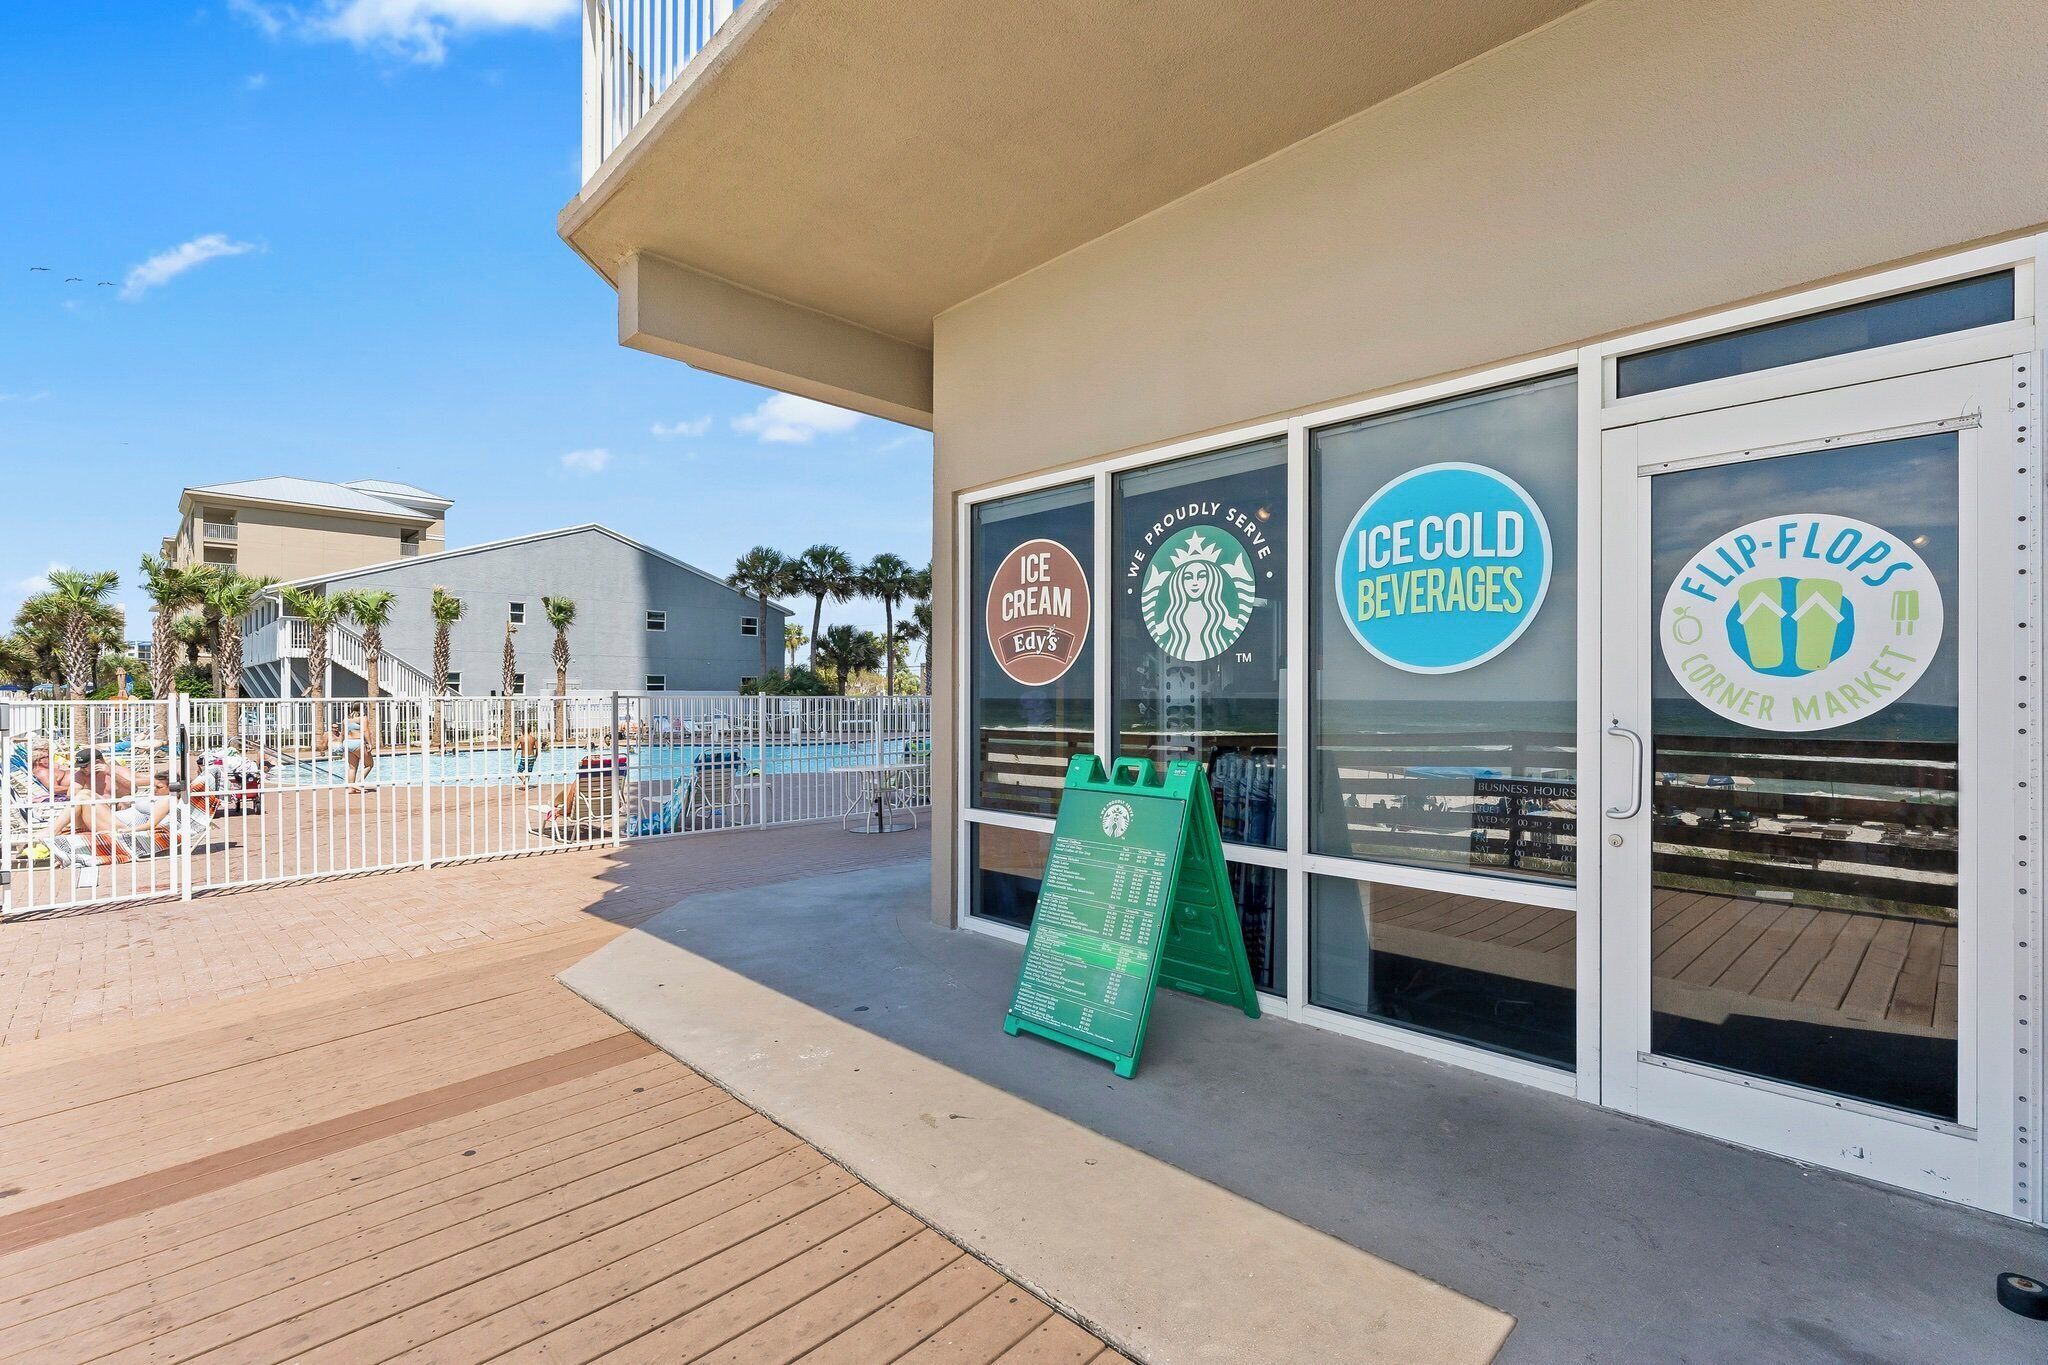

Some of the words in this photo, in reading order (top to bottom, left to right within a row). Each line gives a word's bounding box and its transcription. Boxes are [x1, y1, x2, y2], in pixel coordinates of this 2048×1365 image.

[1128, 550, 1146, 578] WE
[1144, 502, 1221, 546] PROUDLY
[1226, 508, 1272, 560] SERVE
[1358, 518, 1414, 573] ICE
[1418, 510, 1524, 563] COLD
[1681, 521, 1914, 603] FLIP-FLOPS
[1020, 553, 1051, 584] ICE
[1002, 586, 1072, 622] CREAM
[1356, 565, 1523, 622] BEVERAGES
[1012, 628, 1058, 655] Edy's
[1236, 653, 1252, 663] TM
[1681, 653, 1775, 723] CORNER
[1792, 644, 1918, 724] MARKET
[1478, 783, 1528, 794] BUSINESS
[1534, 786, 1577, 798] HOURS
